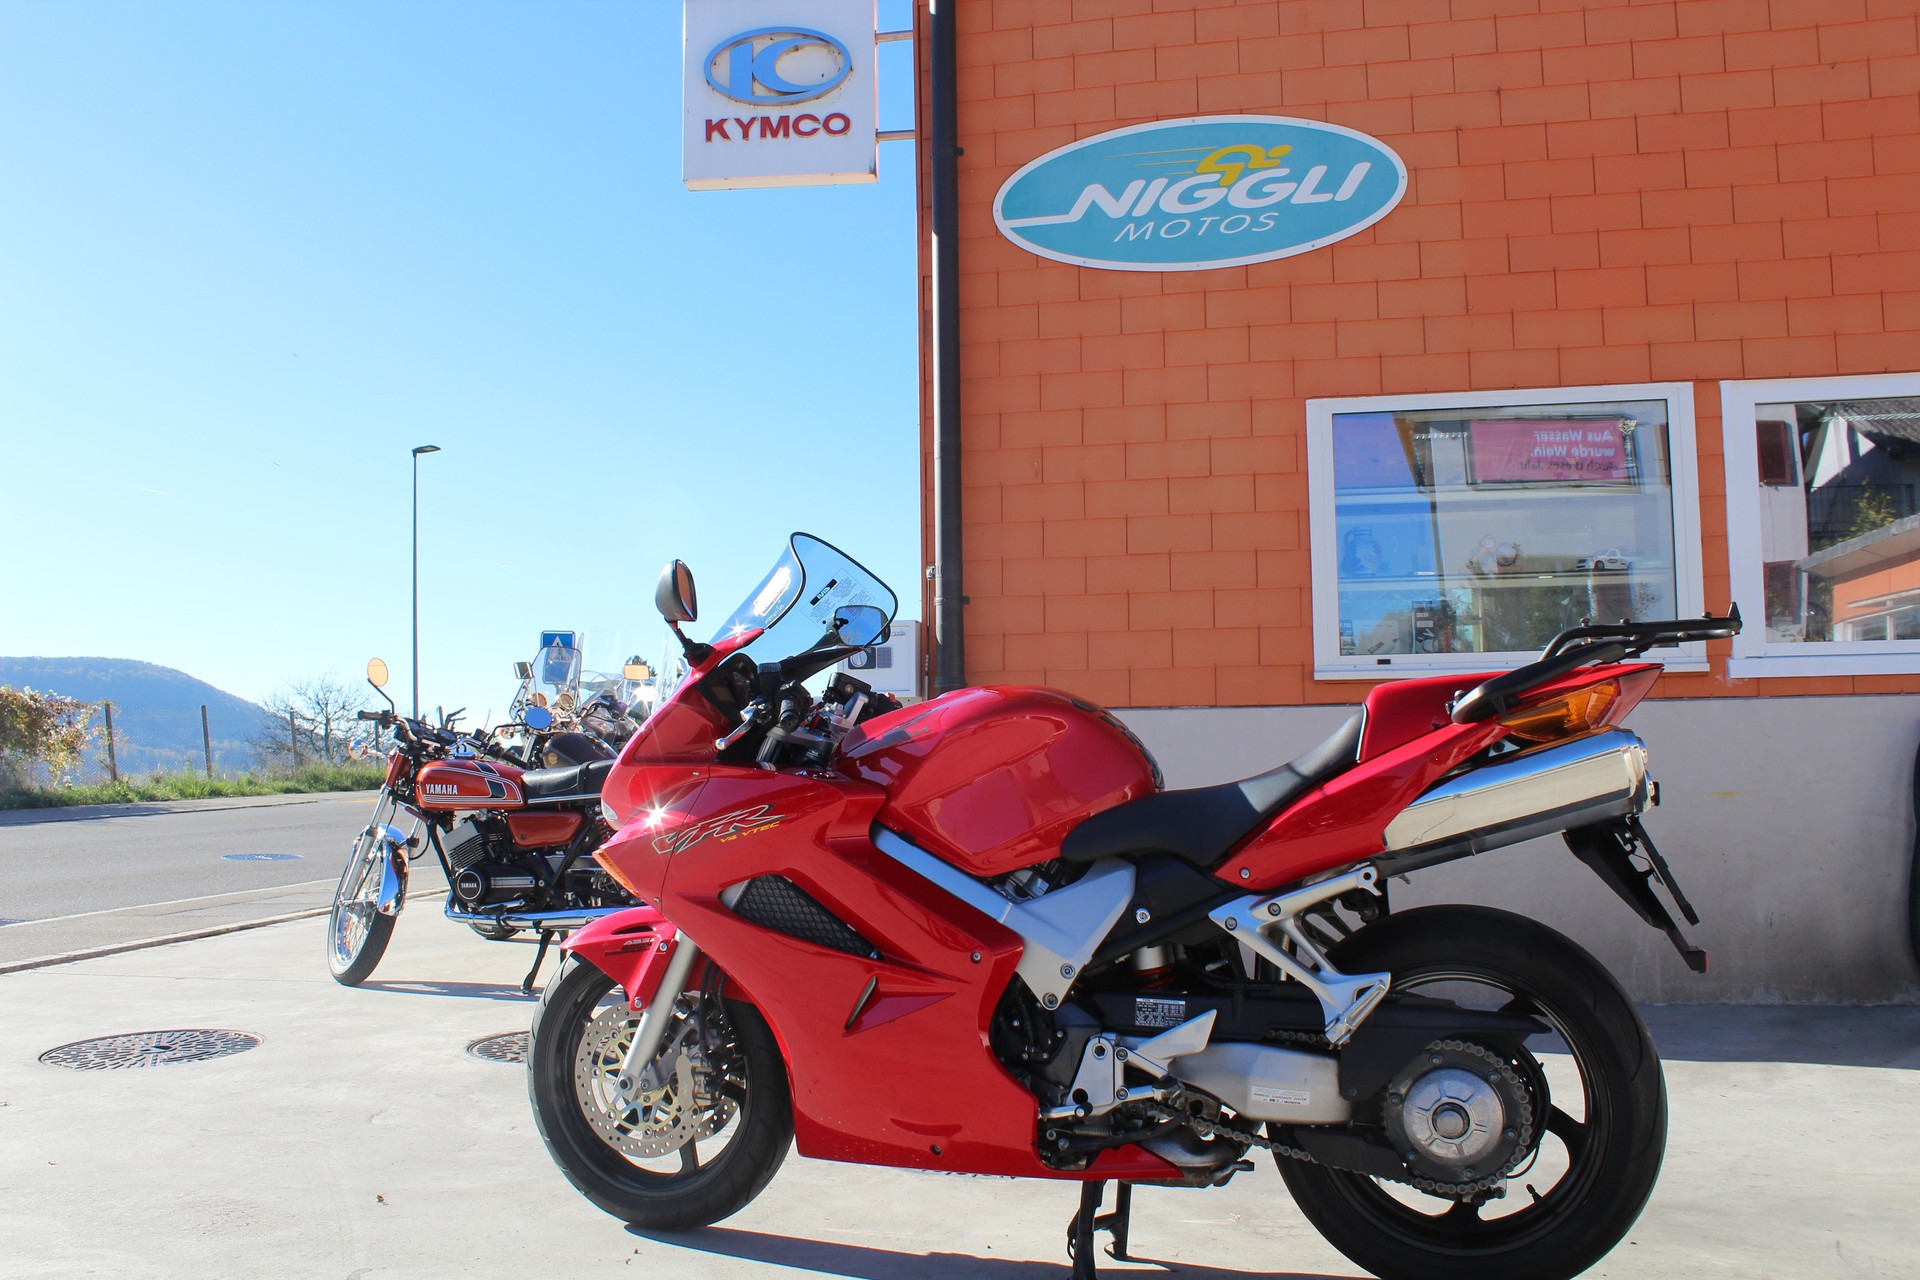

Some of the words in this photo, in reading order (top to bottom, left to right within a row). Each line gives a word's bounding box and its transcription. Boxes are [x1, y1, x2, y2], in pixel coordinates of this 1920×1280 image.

[705, 112, 851, 142] KYMCO
[1067, 161, 1372, 219] NIGGLI
[1113, 212, 1280, 243] MOTOS
[425, 783, 459, 795] YAMAHA
[651, 803, 786, 855] VFR
[742, 820, 780, 837] VTEC
